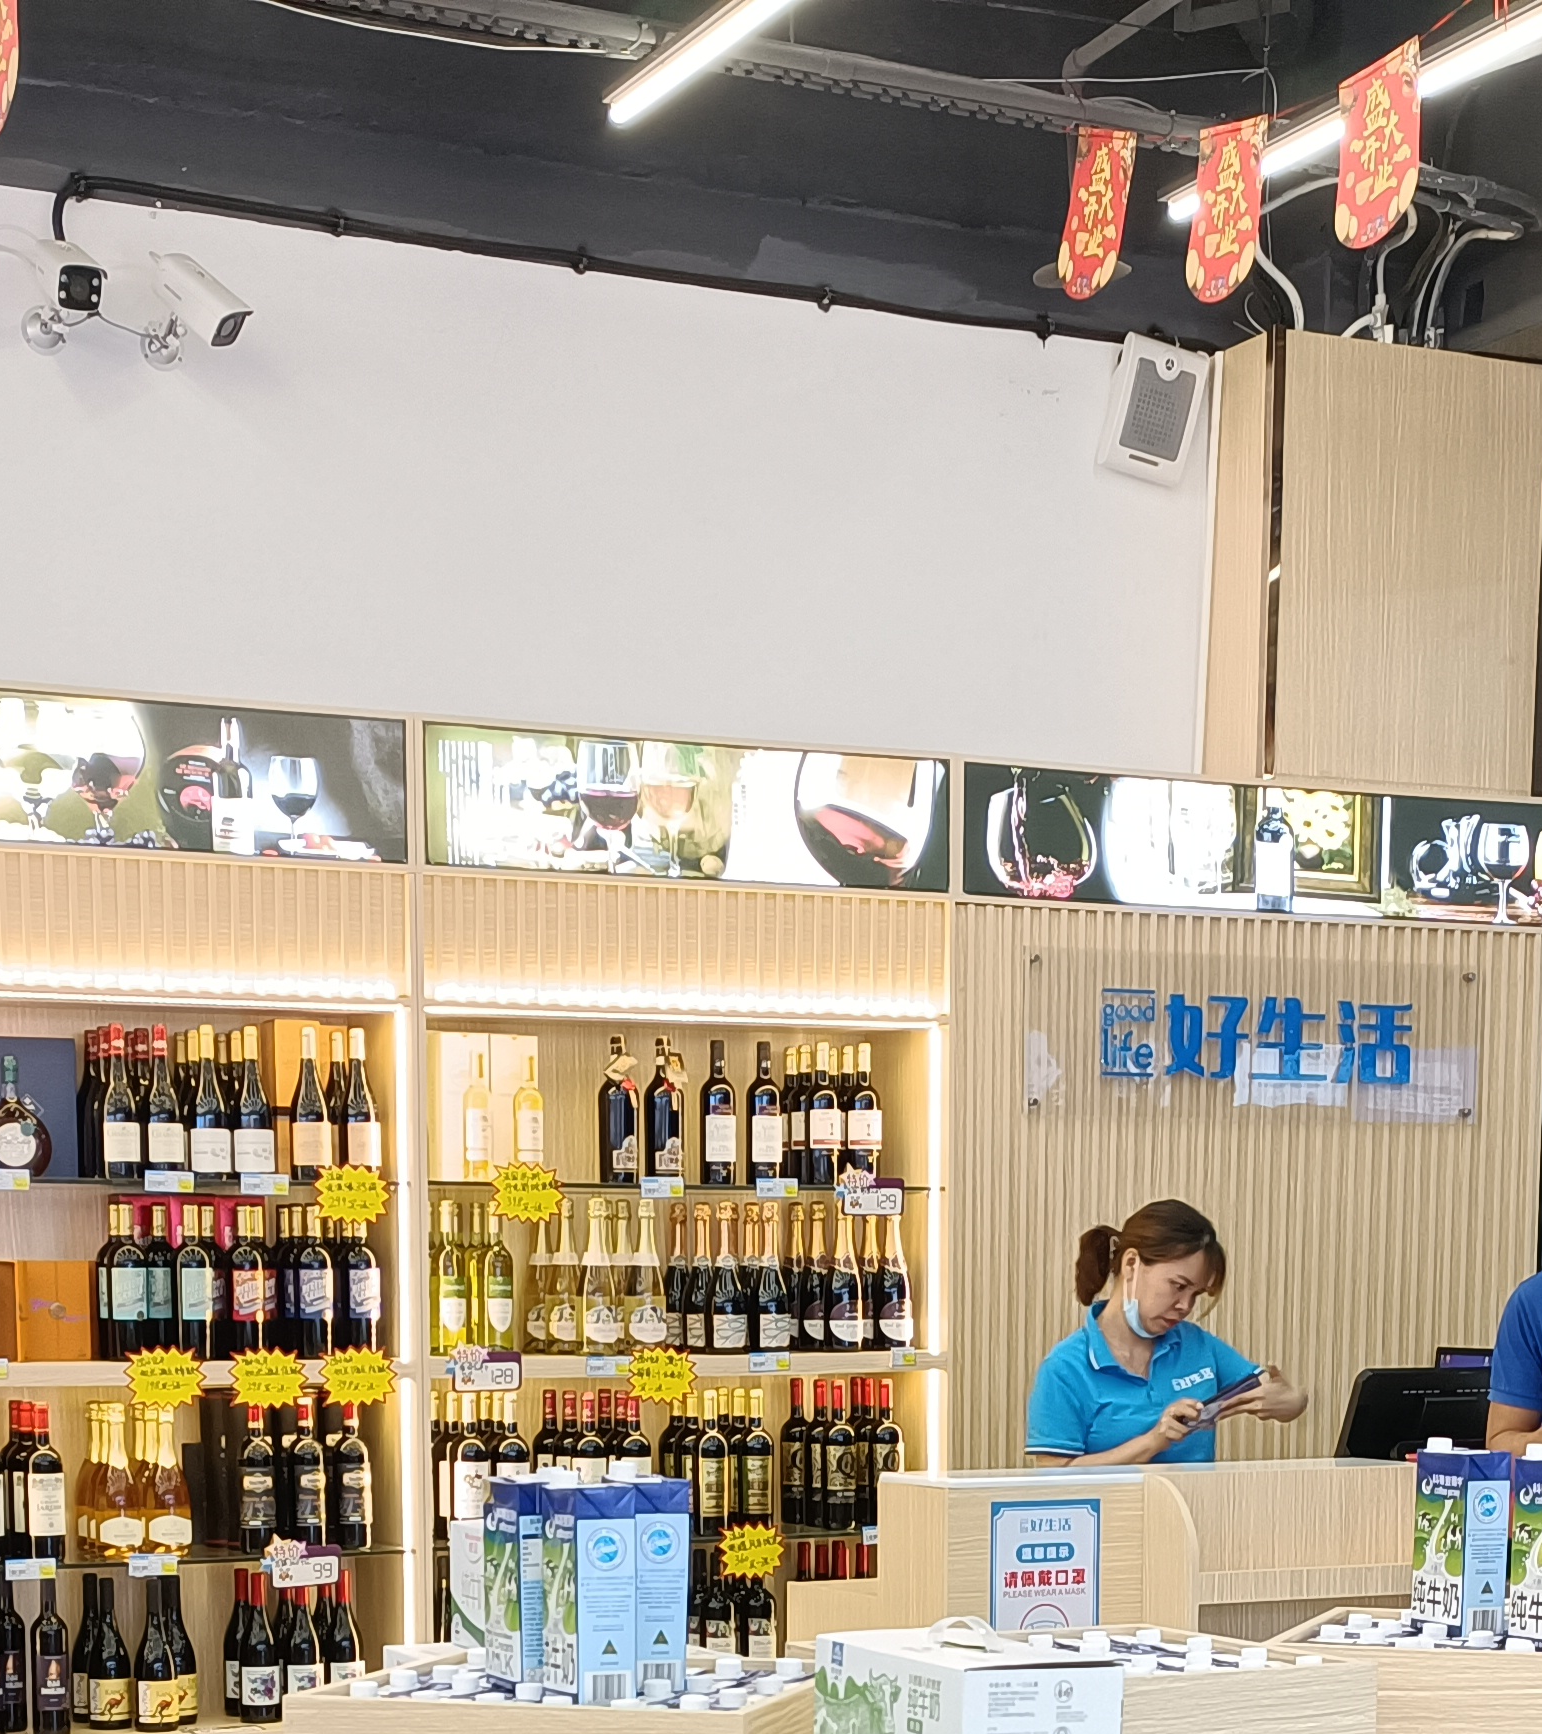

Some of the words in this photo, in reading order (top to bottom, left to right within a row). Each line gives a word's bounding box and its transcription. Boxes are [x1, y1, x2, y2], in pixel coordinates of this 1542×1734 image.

[1358, 77, 1405, 202] 盛大开业
[1081, 143, 1115, 258] 盛大开业
[1211, 138, 1249, 258] 盛大开业
[1102, 997, 1155, 1027] good
[1102, 1028, 1154, 1070] life
[1164, 993, 1414, 1085] 好生活
[846, 1174, 870, 1188] 特价
[876, 1193, 898, 1210] 129
[491, 1367, 514, 1385] 128
[1030, 1518, 1072, 1533] 好生活
[273, 1544, 299, 1559] 特价
[313, 1562, 333, 1580] 99
[1004, 1568, 1087, 1589] 请佩戴口罩
[1003, 1588, 1033, 1599] PLEASE
[1034, 1588, 1057, 1598] WEAR
[1064, 1586, 1087, 1596] MASK
[1412, 1576, 1460, 1619] 纯牛奶
